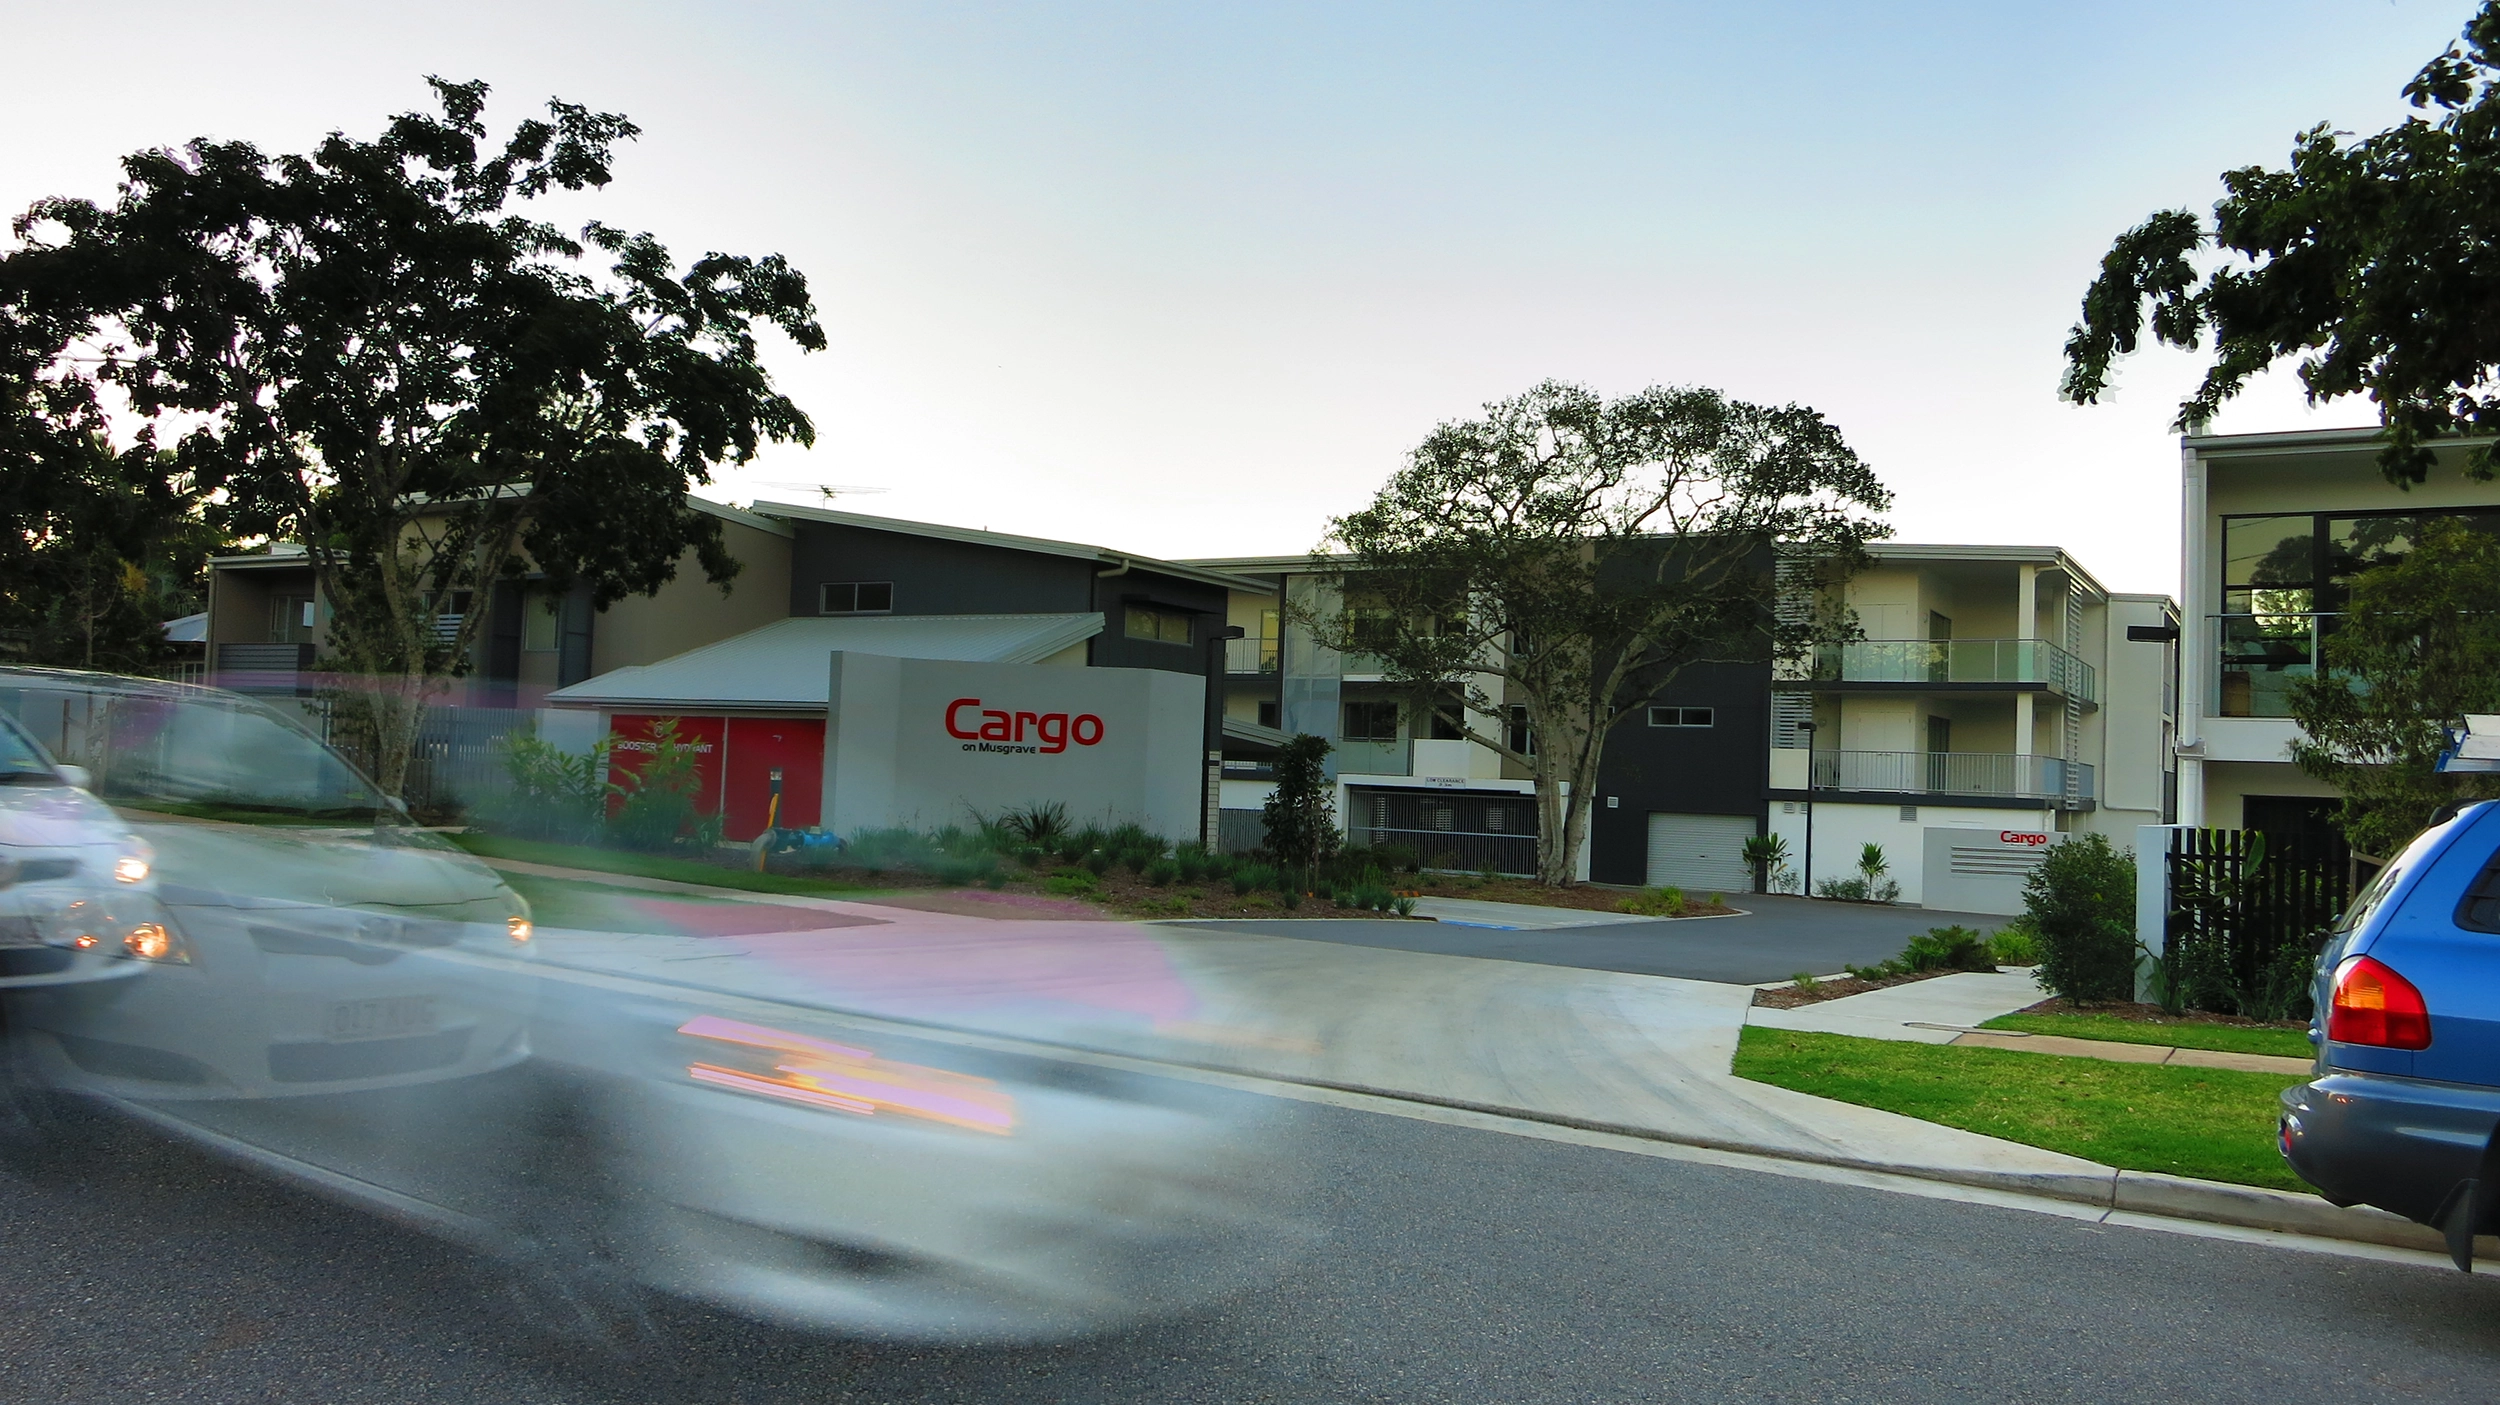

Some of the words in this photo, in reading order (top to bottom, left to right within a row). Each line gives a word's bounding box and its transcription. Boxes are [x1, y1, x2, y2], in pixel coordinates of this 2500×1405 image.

[945, 698, 1104, 754] Cargo
[962, 743, 976, 753] on
[978, 742, 1036, 754] Musgrave
[2000, 830, 2047, 846] Cargo
